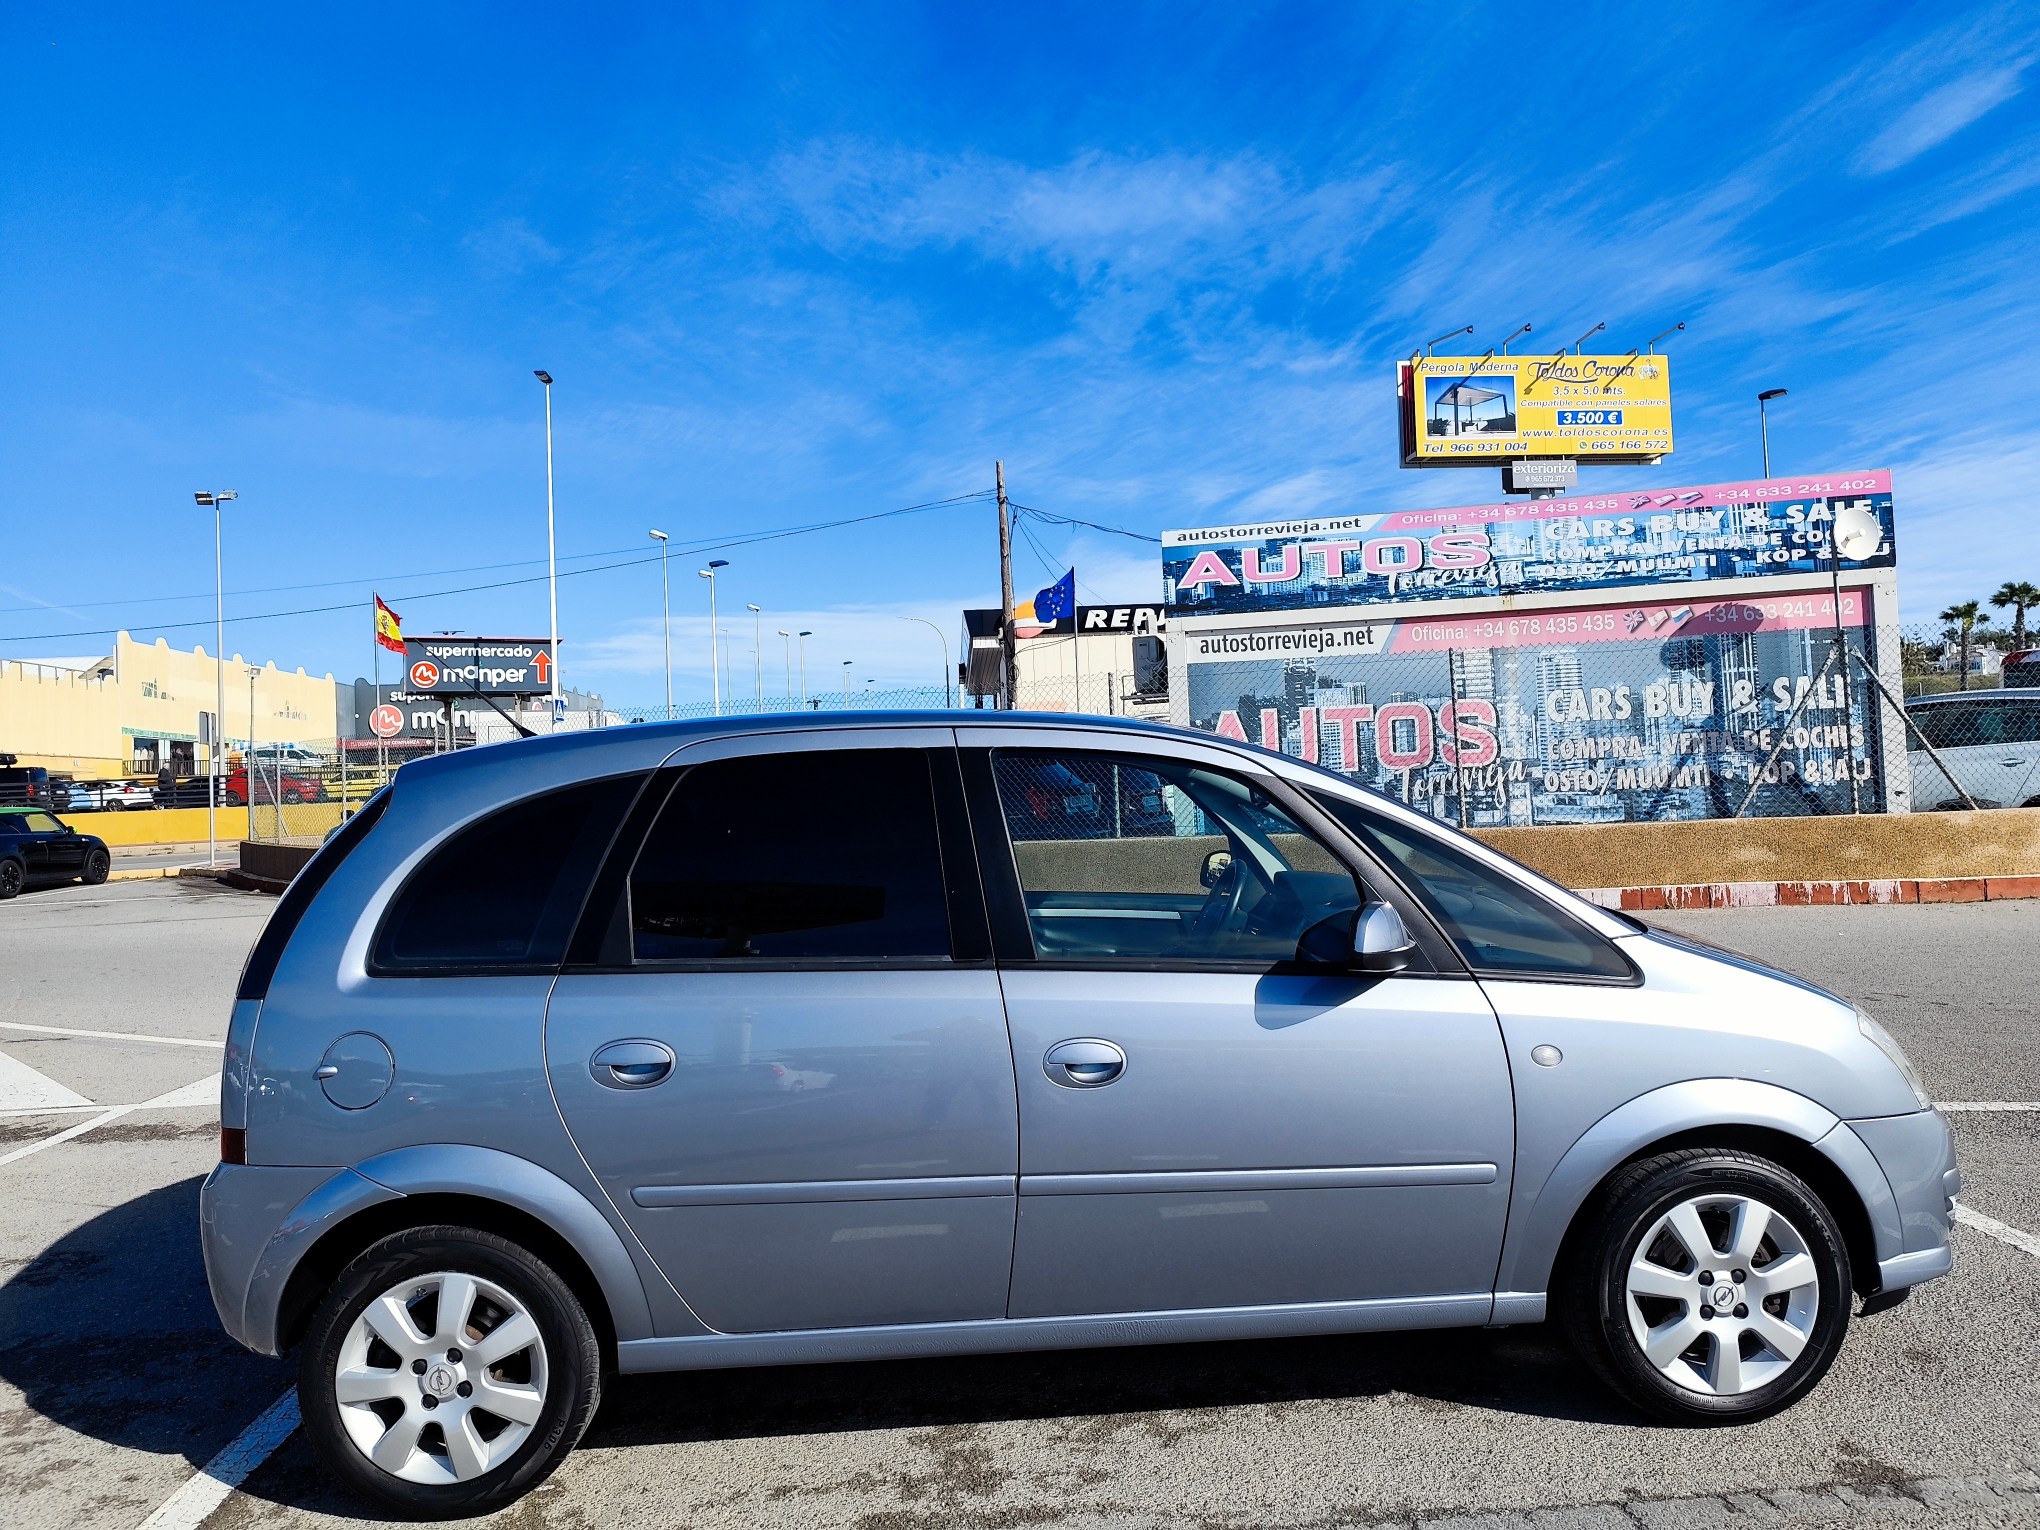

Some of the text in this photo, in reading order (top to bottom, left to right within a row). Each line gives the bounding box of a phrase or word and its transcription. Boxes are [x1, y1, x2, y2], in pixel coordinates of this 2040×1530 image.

[1420, 362, 1519, 374] Pérgola Moderna
[1527, 360, 1635, 382] Toldos Corona
[1520, 399, 1573, 408] Compatible
[1595, 398, 1631, 408] paneles
[1633, 398, 1667, 406] solares
[1562, 411, 1619, 424] 3.500 €
[1522, 428, 1669, 438] www.toldoscorona.es
[1424, 441, 1528, 453] Tel. 966 931 004
[1591, 440, 1668, 450] 665 166 572
[1513, 462, 1576, 474] exterioriza
[1715, 479, 1877, 500] +34 633 241 402
[1401, 499, 1618, 524] Oficina: +34 678 435 435
[1177, 517, 1362, 542] autostorrevieja.net
[1545, 517, 1636, 541] CARS
[1650, 510, 1726, 534] BUY
[1742, 508, 1770, 527] &
[1753, 532, 1783, 546] DE
[1176, 532, 1492, 590] AUTOS
[1756, 547, 1807, 564] KÖP
[1705, 607, 1738, 623] +34
[1743, 603, 1778, 620] 633
[1783, 601, 1816, 618] 241
[1411, 614, 1615, 642] Oficina: +34 678 435 435
[1199, 626, 1374, 653] autostorrevieja.net
[426, 644, 533, 659] supermercado
[443, 665, 528, 688] manper
[1547, 685, 1633, 723] CARS
[1645, 681, 1715, 718] BUY
[1731, 679, 1760, 714] &
[1214, 699, 1499, 772] AUTOS
[1744, 729, 1772, 751] DE
[543, 1416, 566, 1452] P306
